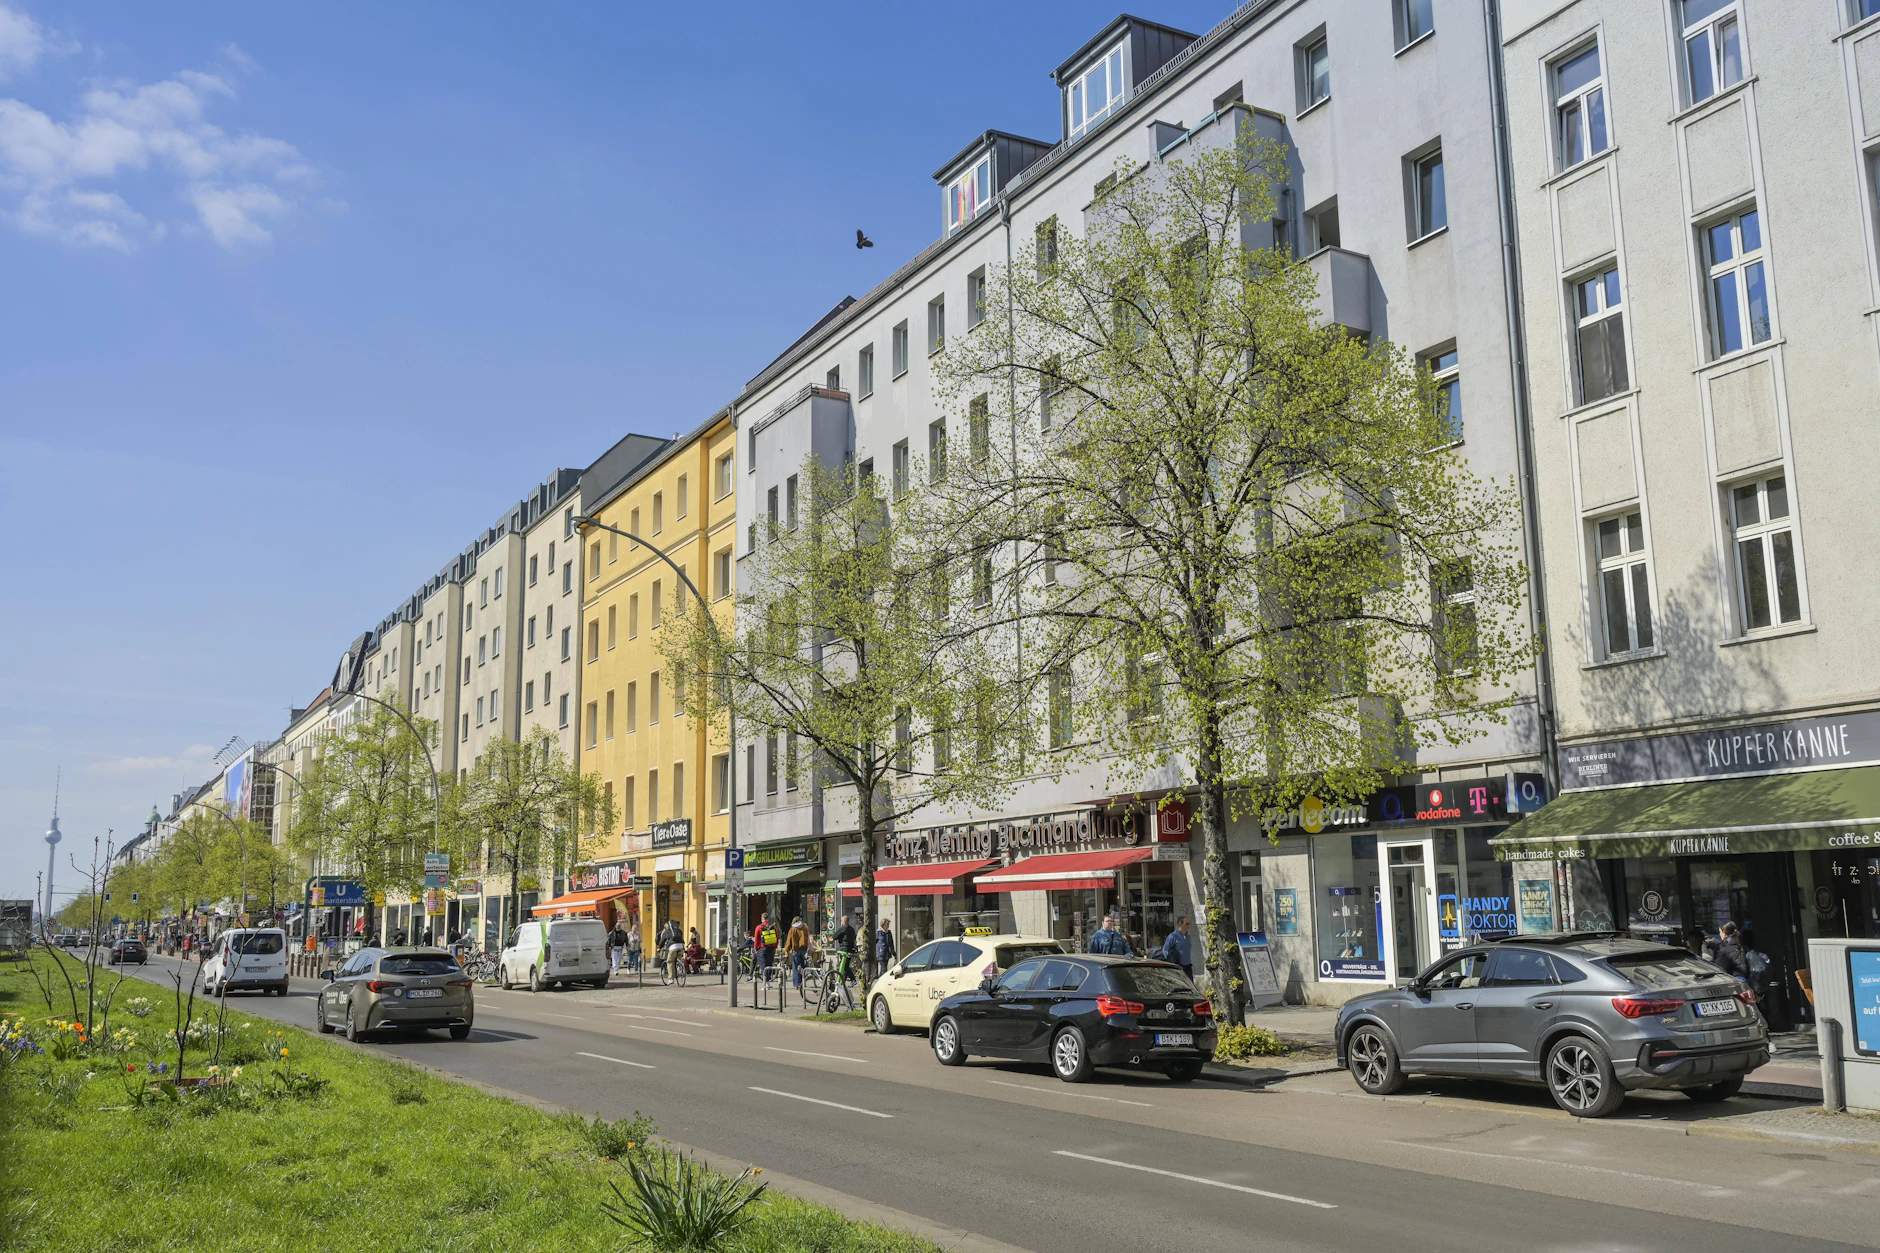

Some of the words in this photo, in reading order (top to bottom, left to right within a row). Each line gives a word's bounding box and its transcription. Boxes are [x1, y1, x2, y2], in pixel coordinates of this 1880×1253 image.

[1707, 732, 1779, 768] KUPFER
[1782, 724, 1851, 761] KANNE
[1582, 752, 1616, 762] SERVIEREN
[1578, 763, 1607, 771] BERLINER
[1415, 807, 1460, 820] vodafone
[1828, 832, 1870, 846] coffee
[729, 851, 740, 867] P
[756, 848, 793, 864] GRILLHAUS
[1504, 847, 1554, 861] handmade
[1557, 846, 1586, 859] cakes
[599, 865, 620, 886] BISTRO
[336, 884, 346, 897] U
[1521, 892, 1548, 901] HANDY
[1462, 896, 1510, 911] HANDY
[1522, 900, 1550, 909] EINFACH
[1463, 913, 1517, 928] DOKTOR
[1320, 960, 1334, 978] O2
[928, 986, 946, 1001] Uber
[1701, 1004, 1707, 1013] B
[1720, 1001, 1734, 1011] 105
[1863, 1007, 1877, 1015] auf
